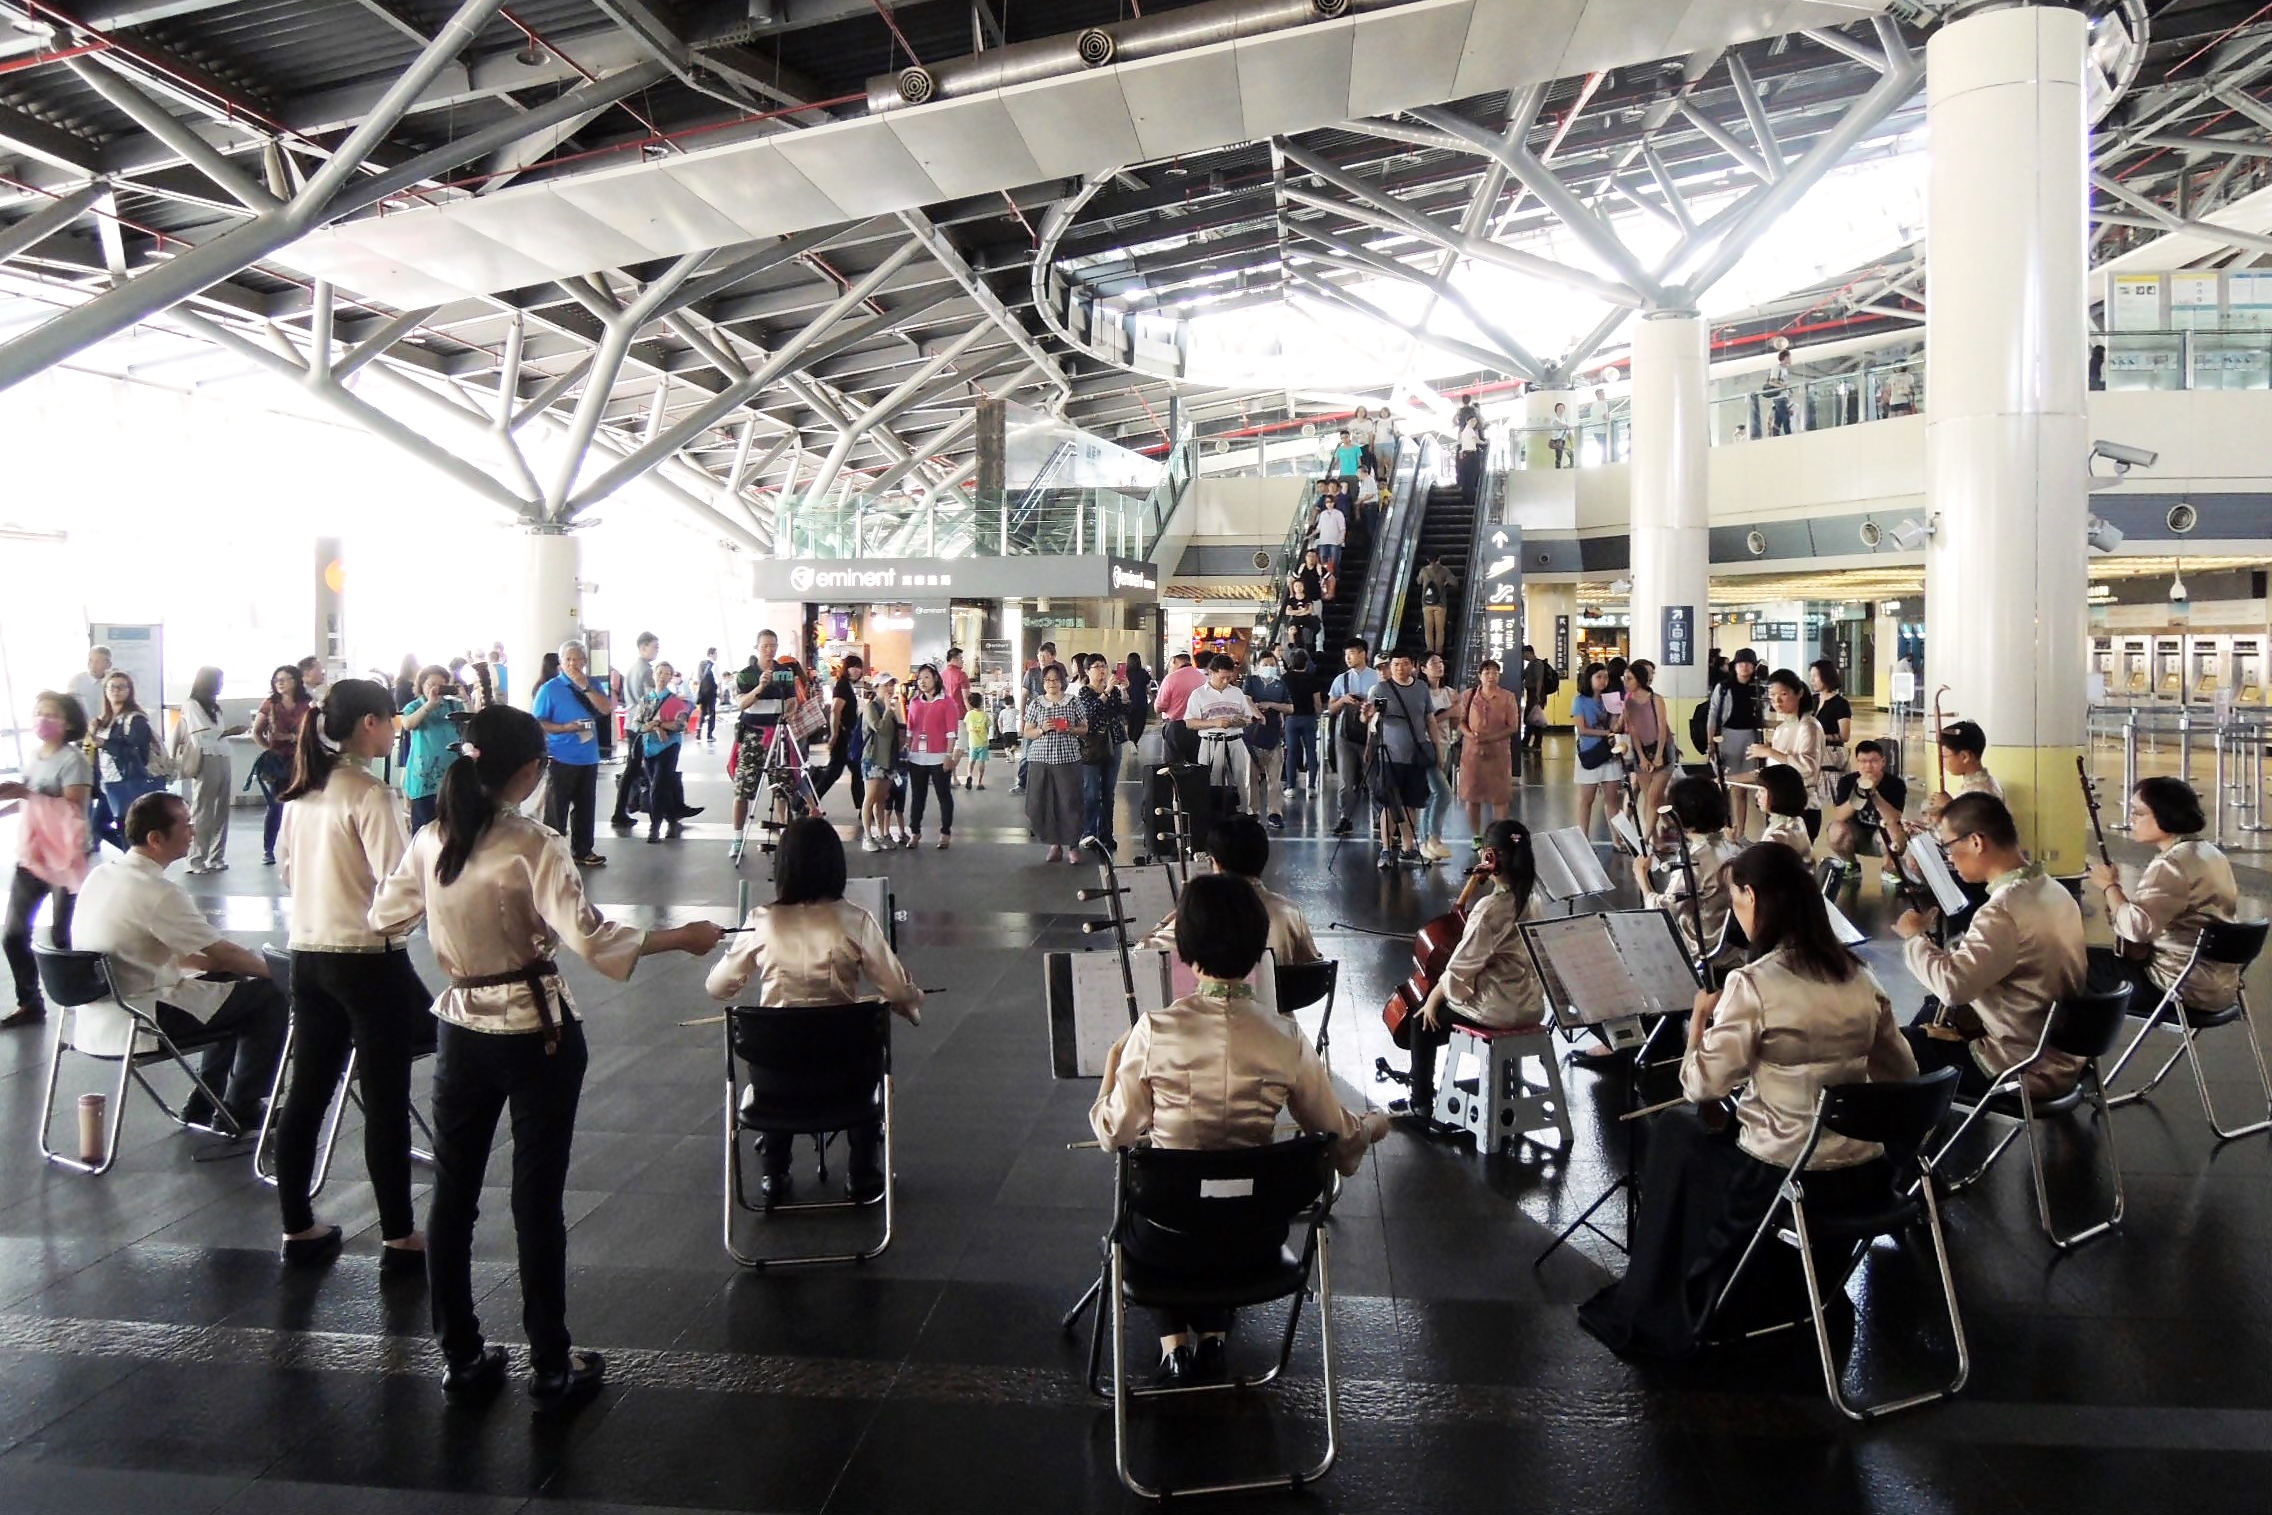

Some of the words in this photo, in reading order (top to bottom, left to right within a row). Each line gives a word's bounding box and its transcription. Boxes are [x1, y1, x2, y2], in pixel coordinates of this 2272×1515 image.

[815, 567, 896, 587] eminent
[1505, 618, 1515, 629] To
[1505, 630, 1515, 650] train
